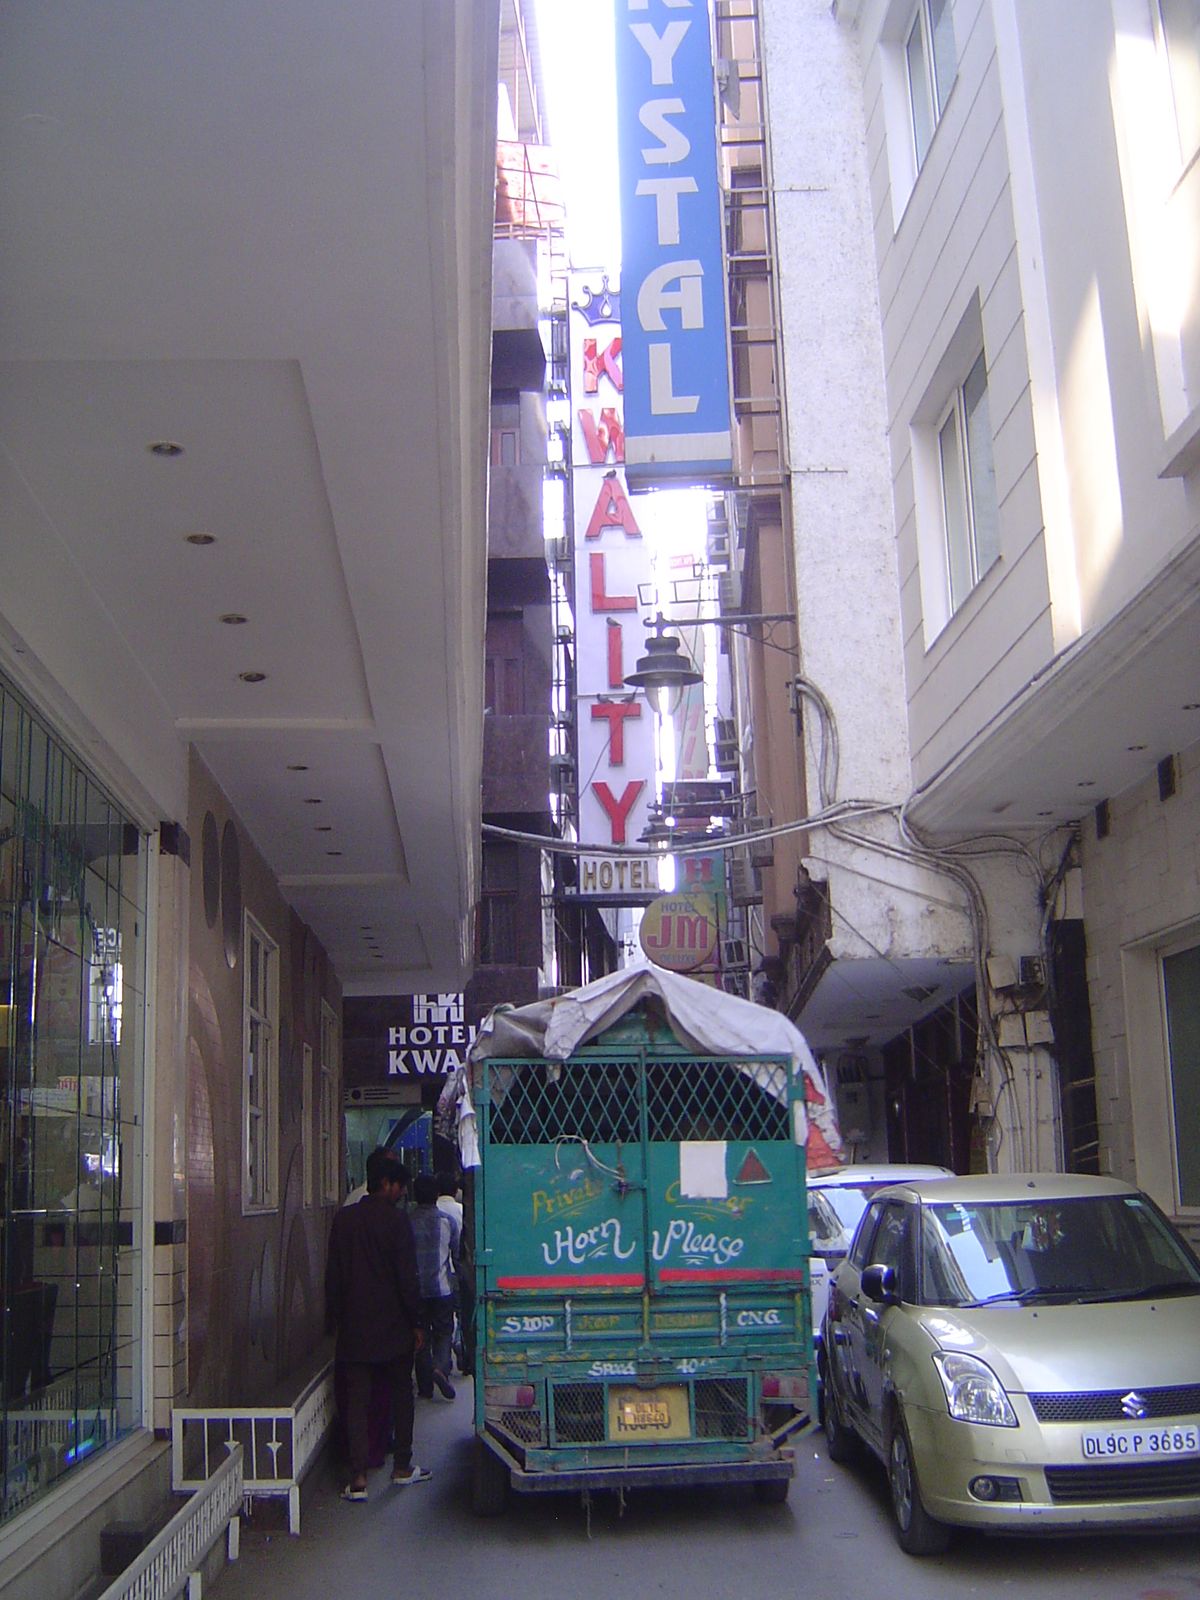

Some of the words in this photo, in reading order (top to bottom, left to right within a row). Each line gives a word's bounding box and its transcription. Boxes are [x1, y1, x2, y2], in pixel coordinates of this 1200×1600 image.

[627, 0, 705, 416] YSTAL
[582, 859, 657, 892] HOTEL
[388, 1048, 464, 1074] KWA
[542, 1218, 636, 1265] Horn
[652, 1219, 744, 1265] Please
[1086, 1435, 1128, 1455] DL9C
[1133, 1434, 1143, 1453] P
[1149, 1431, 1196, 1452] 3685
